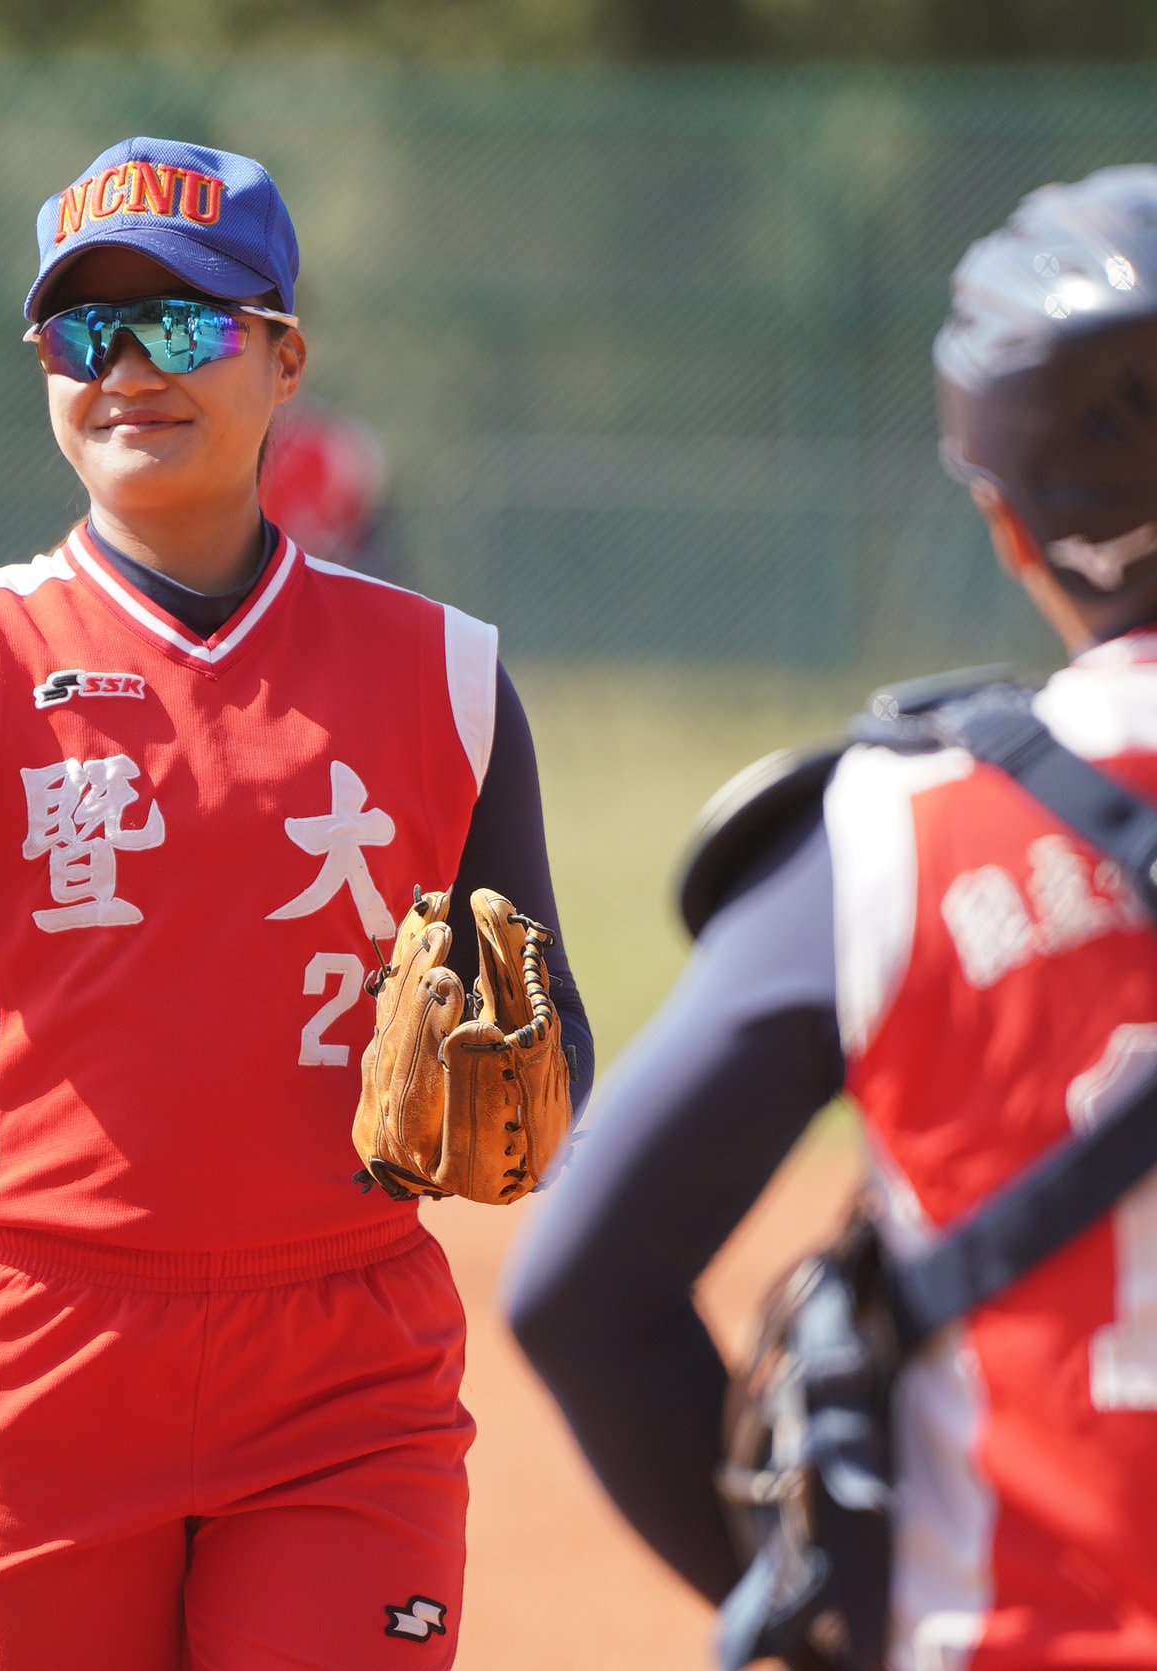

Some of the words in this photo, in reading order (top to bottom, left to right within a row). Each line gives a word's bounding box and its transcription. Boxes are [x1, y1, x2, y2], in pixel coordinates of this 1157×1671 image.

[54, 161, 224, 245] NCNU
[83, 676, 142, 696] SSK
[298, 952, 365, 1067] 2
